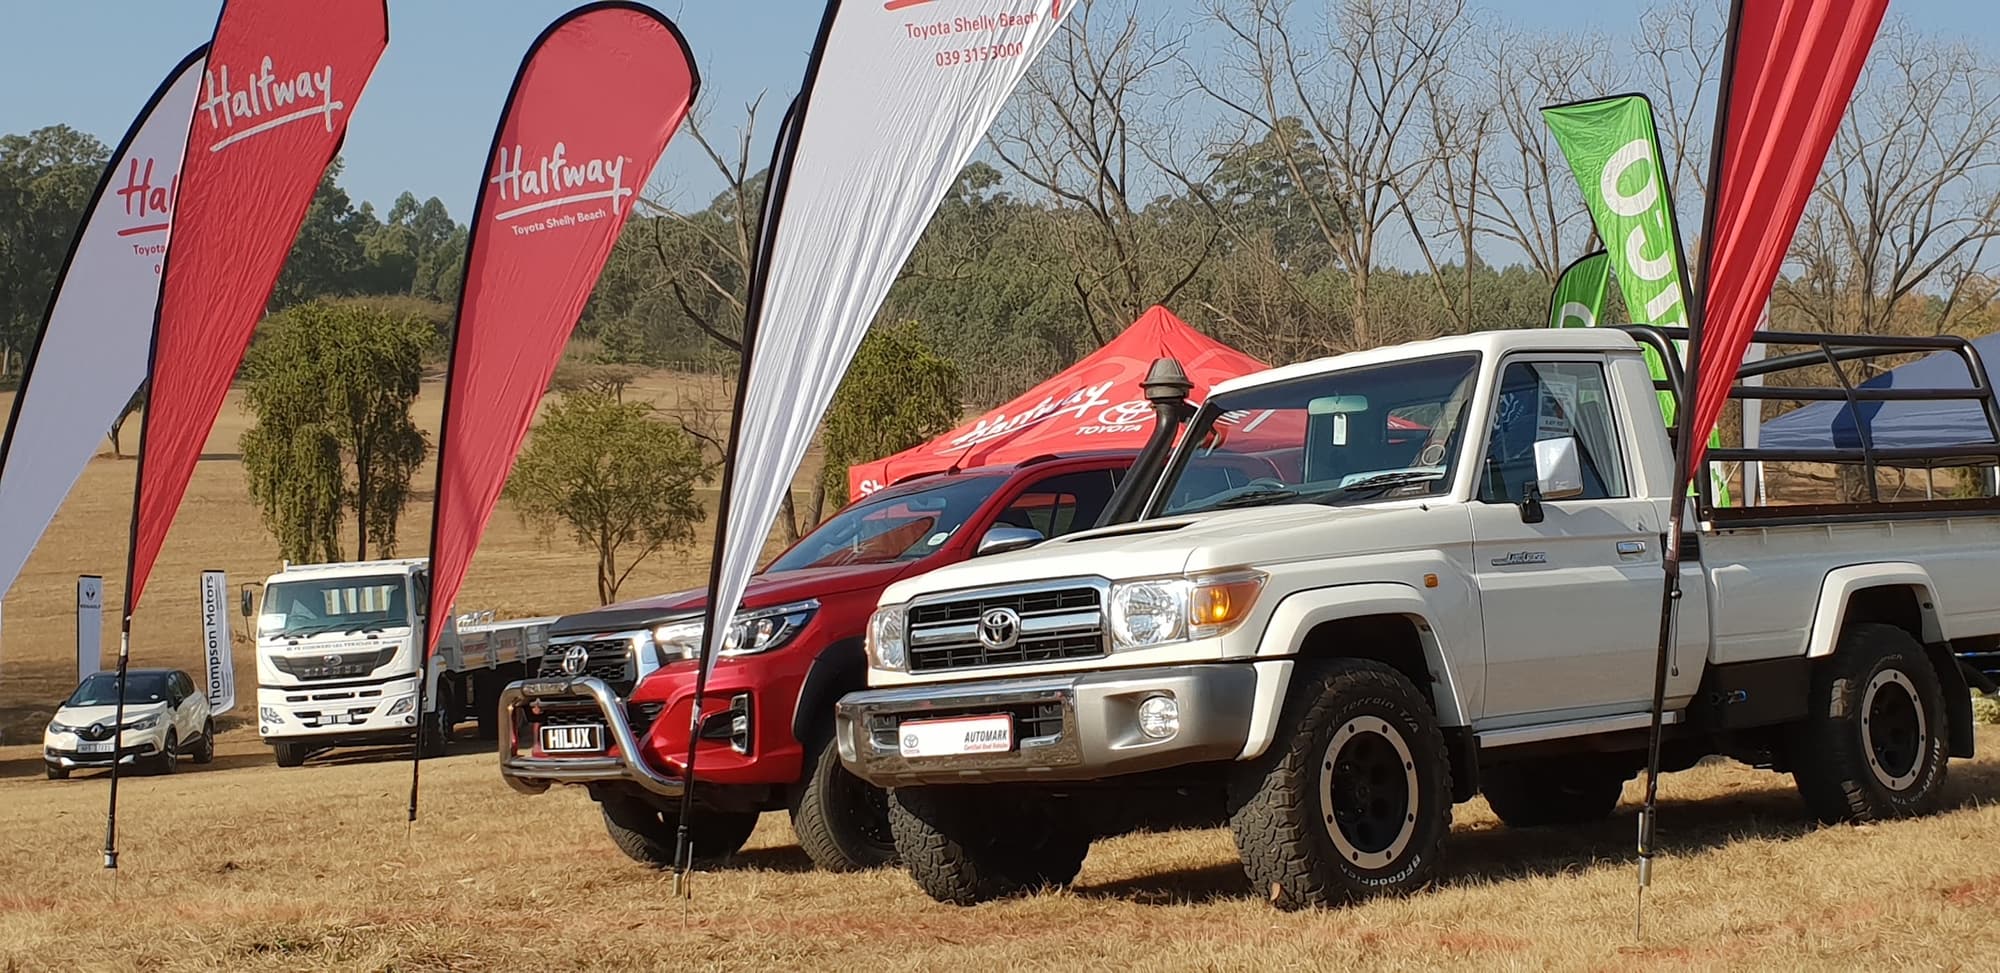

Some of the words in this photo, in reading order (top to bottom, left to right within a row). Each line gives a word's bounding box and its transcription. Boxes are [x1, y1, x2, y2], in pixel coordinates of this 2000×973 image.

[904, 22, 950, 40] Toyota
[954, 15, 995, 33] Shelly
[999, 12, 1038, 28] Beach
[936, 51, 961, 67] 039
[963, 47, 988, 63] 315
[991, 42, 1023, 60] 3000
[199, 55, 343, 133] Halfway
[490, 142, 632, 216] Halfway
[512, 223, 545, 236] Toyota
[546, 215, 576, 229] Shelly
[577, 208, 606, 223] Beach
[1075, 424, 1142, 436] TOYOTA
[206, 575, 216, 627] Motors
[206, 630, 222, 707] Thompson
[549, 728, 591, 749] HILUX
[964, 729, 1008, 743] AUTOMARK
